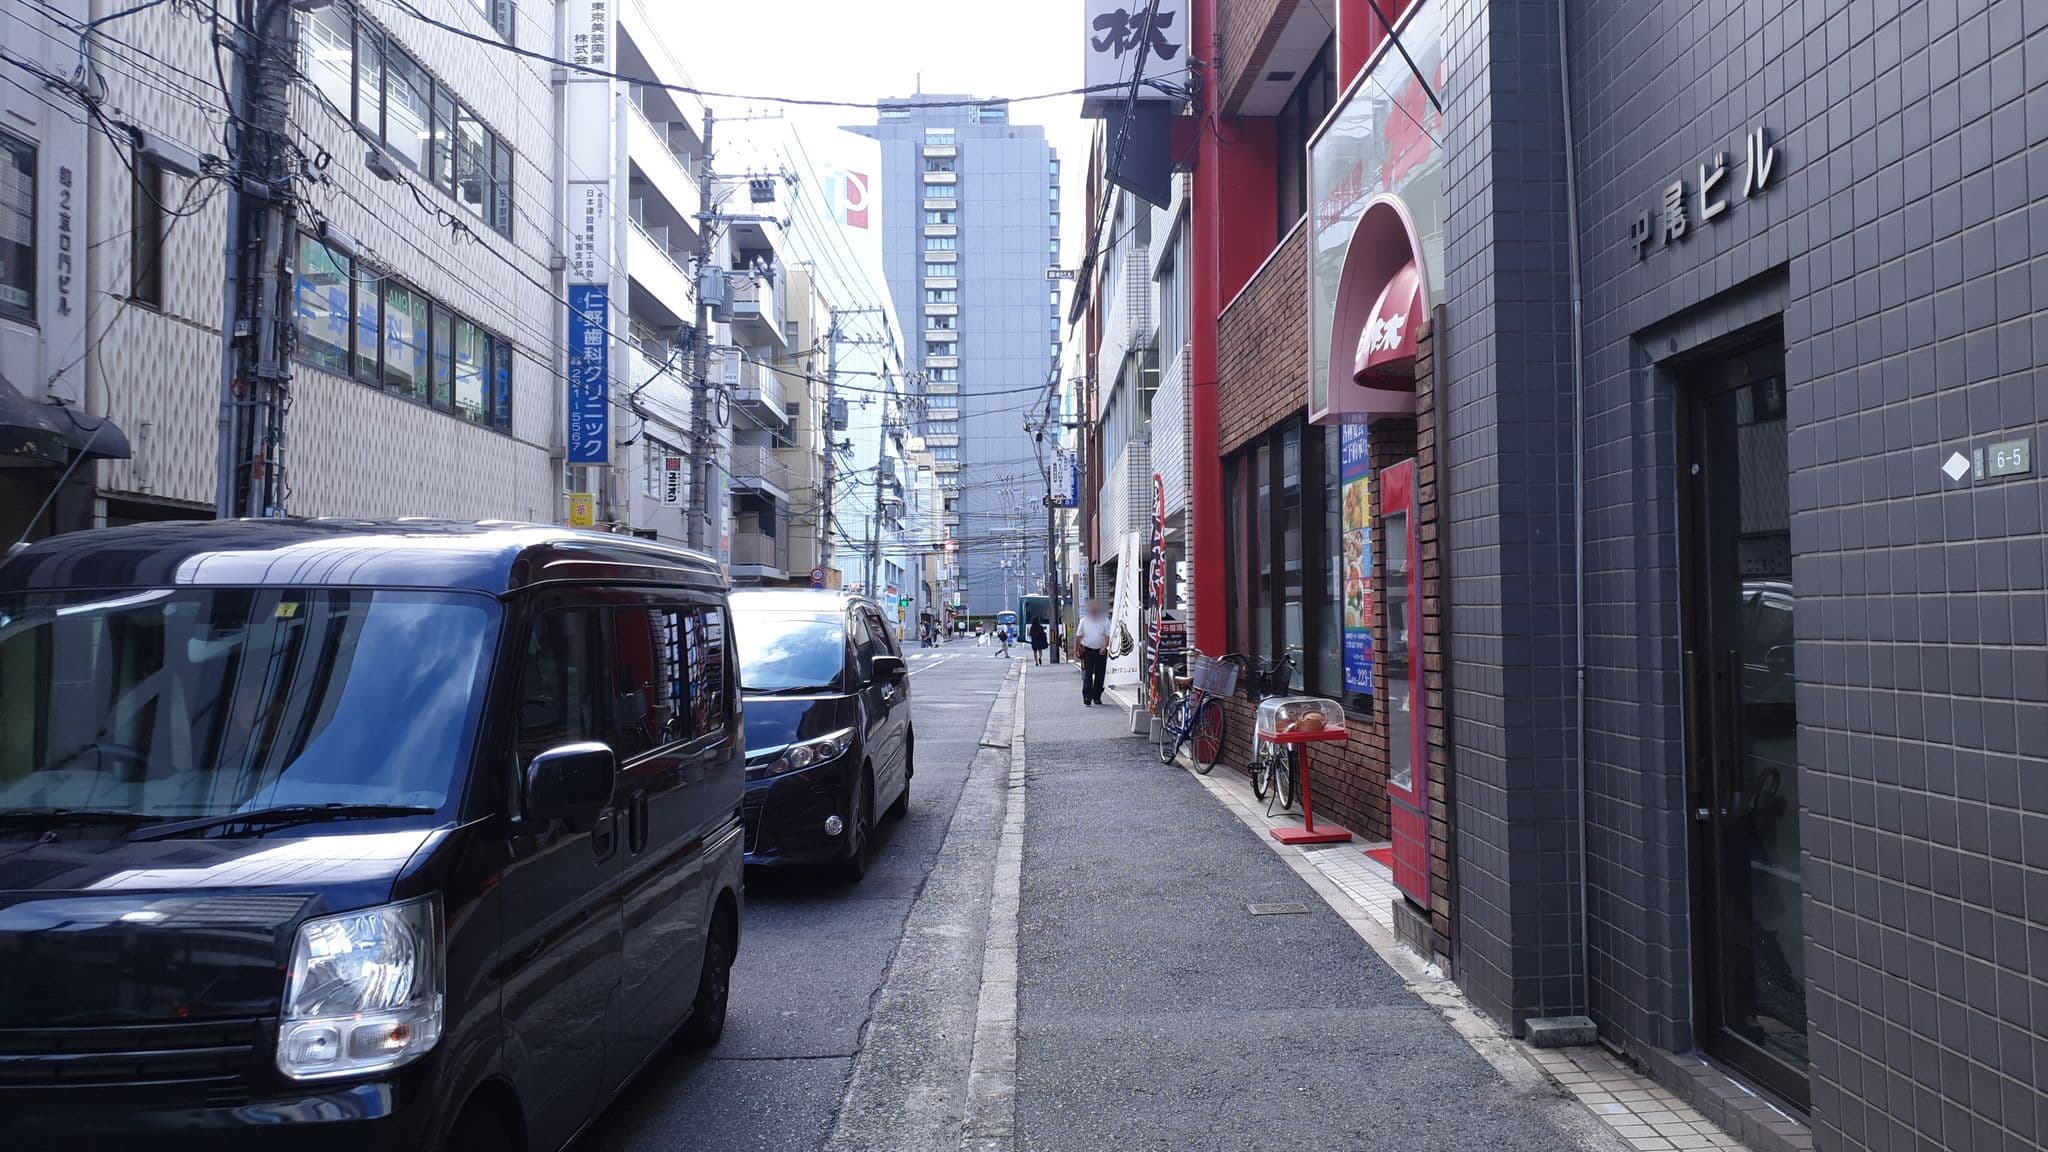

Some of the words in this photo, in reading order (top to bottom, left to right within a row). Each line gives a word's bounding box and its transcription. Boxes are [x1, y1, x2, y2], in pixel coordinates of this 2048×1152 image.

[591, 2, 605, 64] 東京美装興業
[1090, 7, 1182, 61] 林
[1629, 126, 1775, 261] 中尾ビル
[584, 291, 604, 457] 仁野歯科クリニック
[667, 472, 677, 502] ユニオン
[1997, 448, 2021, 468] 6-5
